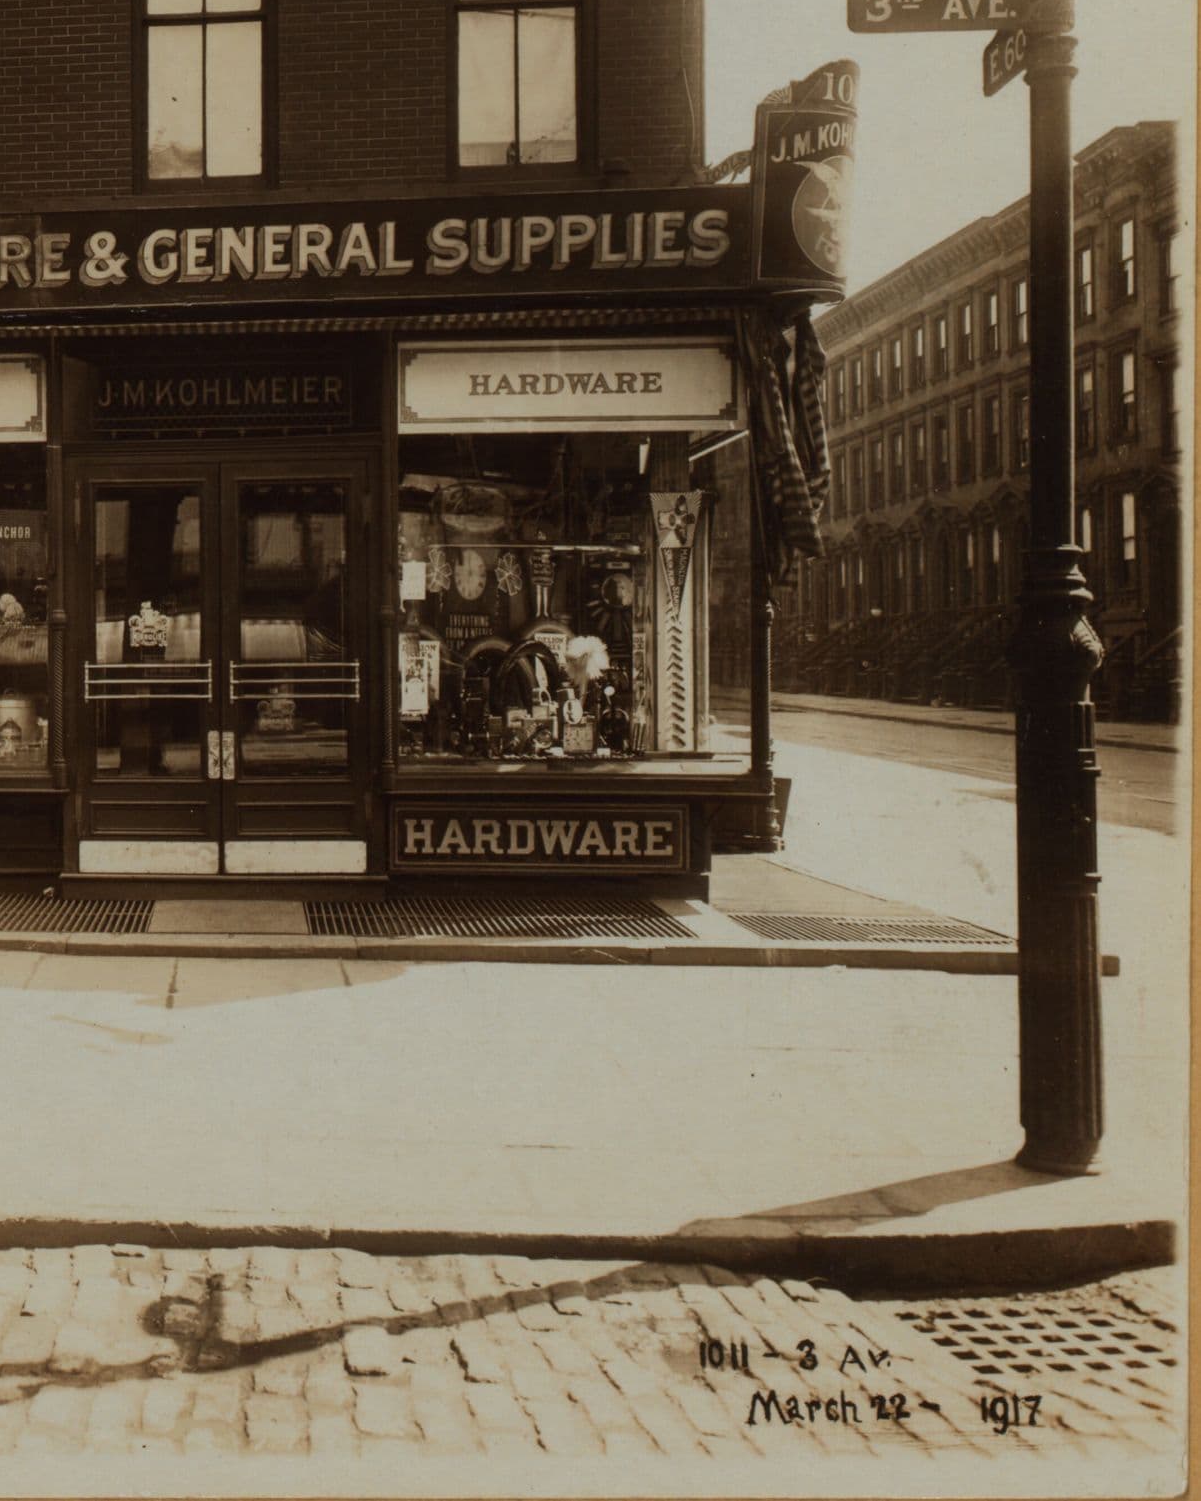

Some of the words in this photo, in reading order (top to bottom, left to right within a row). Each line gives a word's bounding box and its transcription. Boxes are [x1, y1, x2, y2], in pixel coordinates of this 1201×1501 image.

[79, 230, 130, 288] &
[137, 221, 415, 285] GENERAL
[425, 208, 731, 277] SUPPLIES
[468, 372, 664, 397] HARDWARE
[404, 818, 674, 857] HARDWARE
